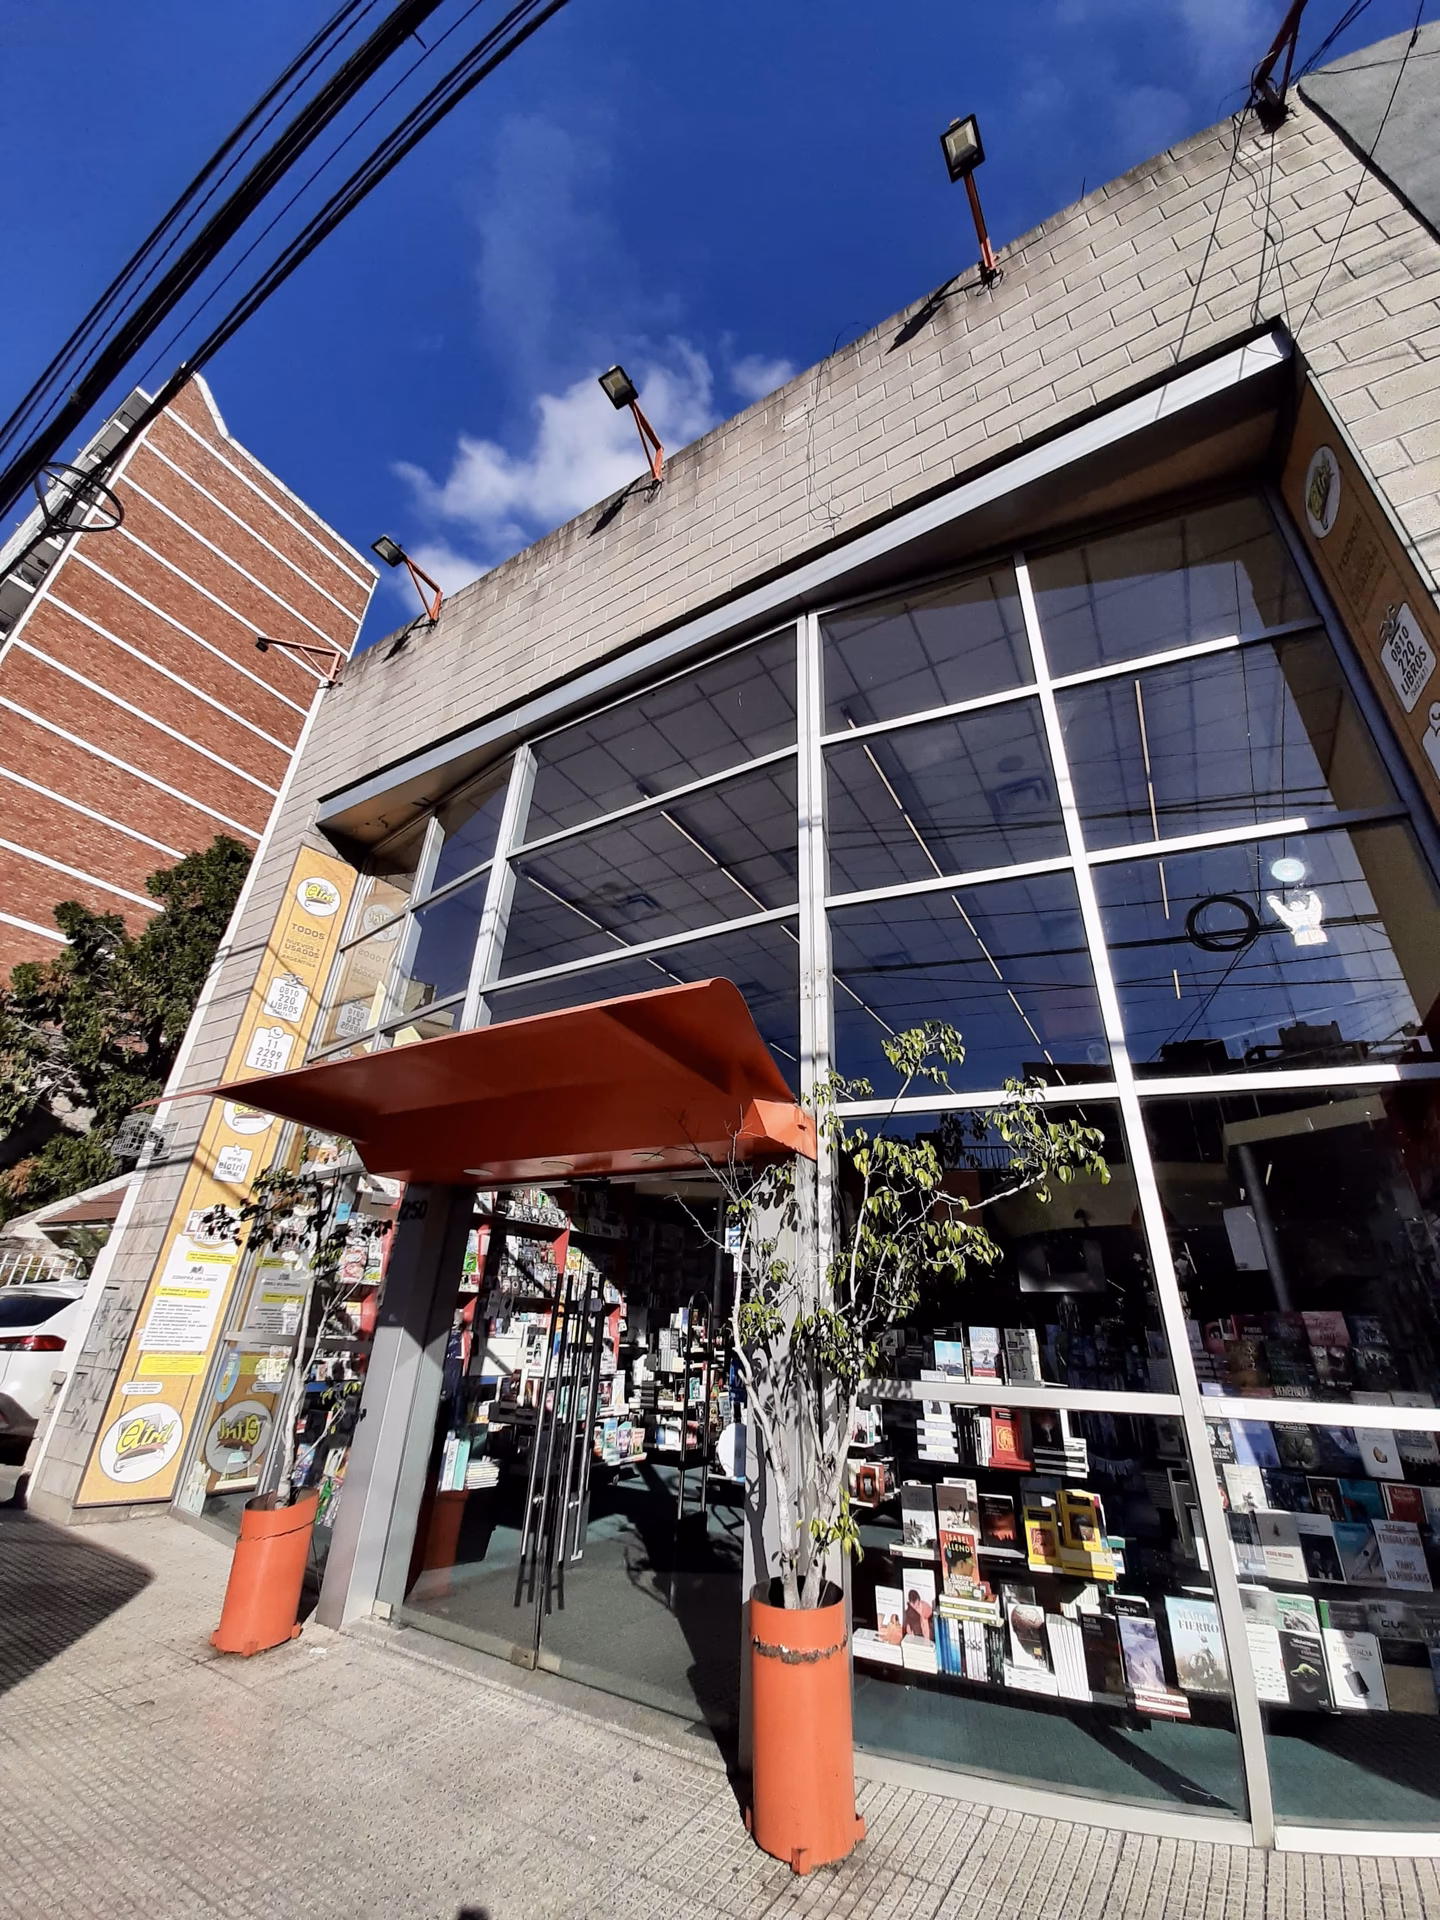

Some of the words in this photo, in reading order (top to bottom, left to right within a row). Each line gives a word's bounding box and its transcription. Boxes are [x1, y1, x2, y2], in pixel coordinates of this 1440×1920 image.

[1390, 625, 1410, 662] 0810
[1397, 640, 1416, 676] 220
[1400, 645, 1427, 697] LIBROS
[291, 922, 326, 940] TODOS
[284, 943, 320, 959] USADOS
[279, 986, 300, 998] 0810
[278, 993, 296, 1005] 220
[270, 1000, 299, 1014] LIBROS
[256, 1047, 283, 1060] 2299
[255, 1057, 279, 1070] 1231
[218, 1161, 247, 1172] elatril
[945, 1533, 970, 1545] ISABEL
[942, 1542, 975, 1554] ALLENDE
[1178, 1619, 1219, 1634] FIERRO
